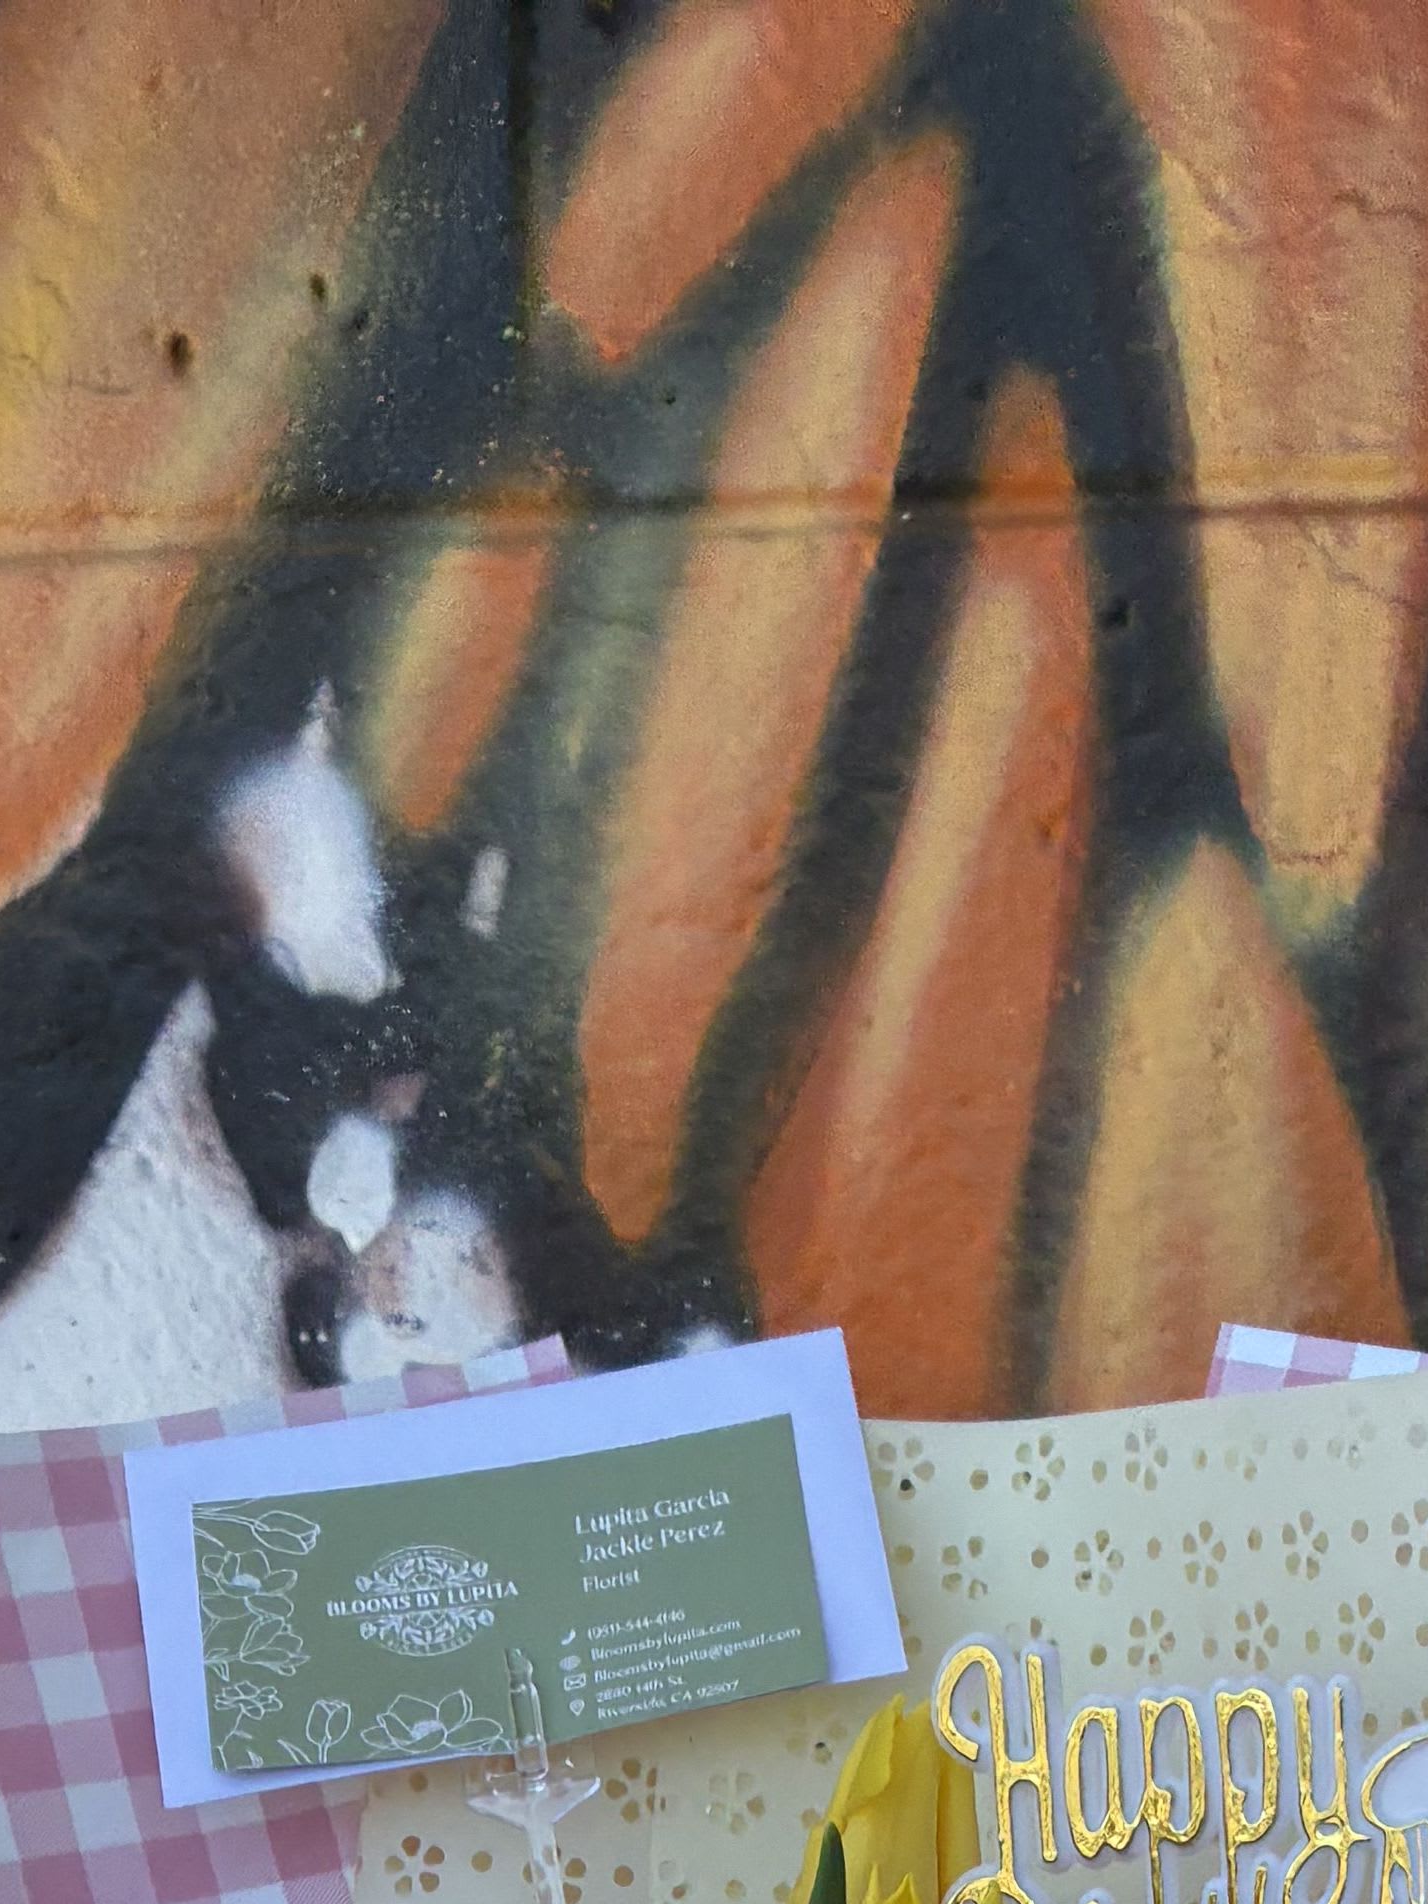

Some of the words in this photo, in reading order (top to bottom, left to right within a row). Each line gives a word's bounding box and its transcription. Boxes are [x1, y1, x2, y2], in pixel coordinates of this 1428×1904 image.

[575, 1506, 649, 1536] Lupita
[654, 1488, 731, 1518] Garcia
[579, 1534, 654, 1564] Jackie
[661, 1520, 726, 1549] Perez
[326, 1594, 411, 1617] BLOOMS
[416, 1591, 441, 1608] BY
[447, 1580, 519, 1605] LUPITA
[582, 1569, 641, 1593] Florist
